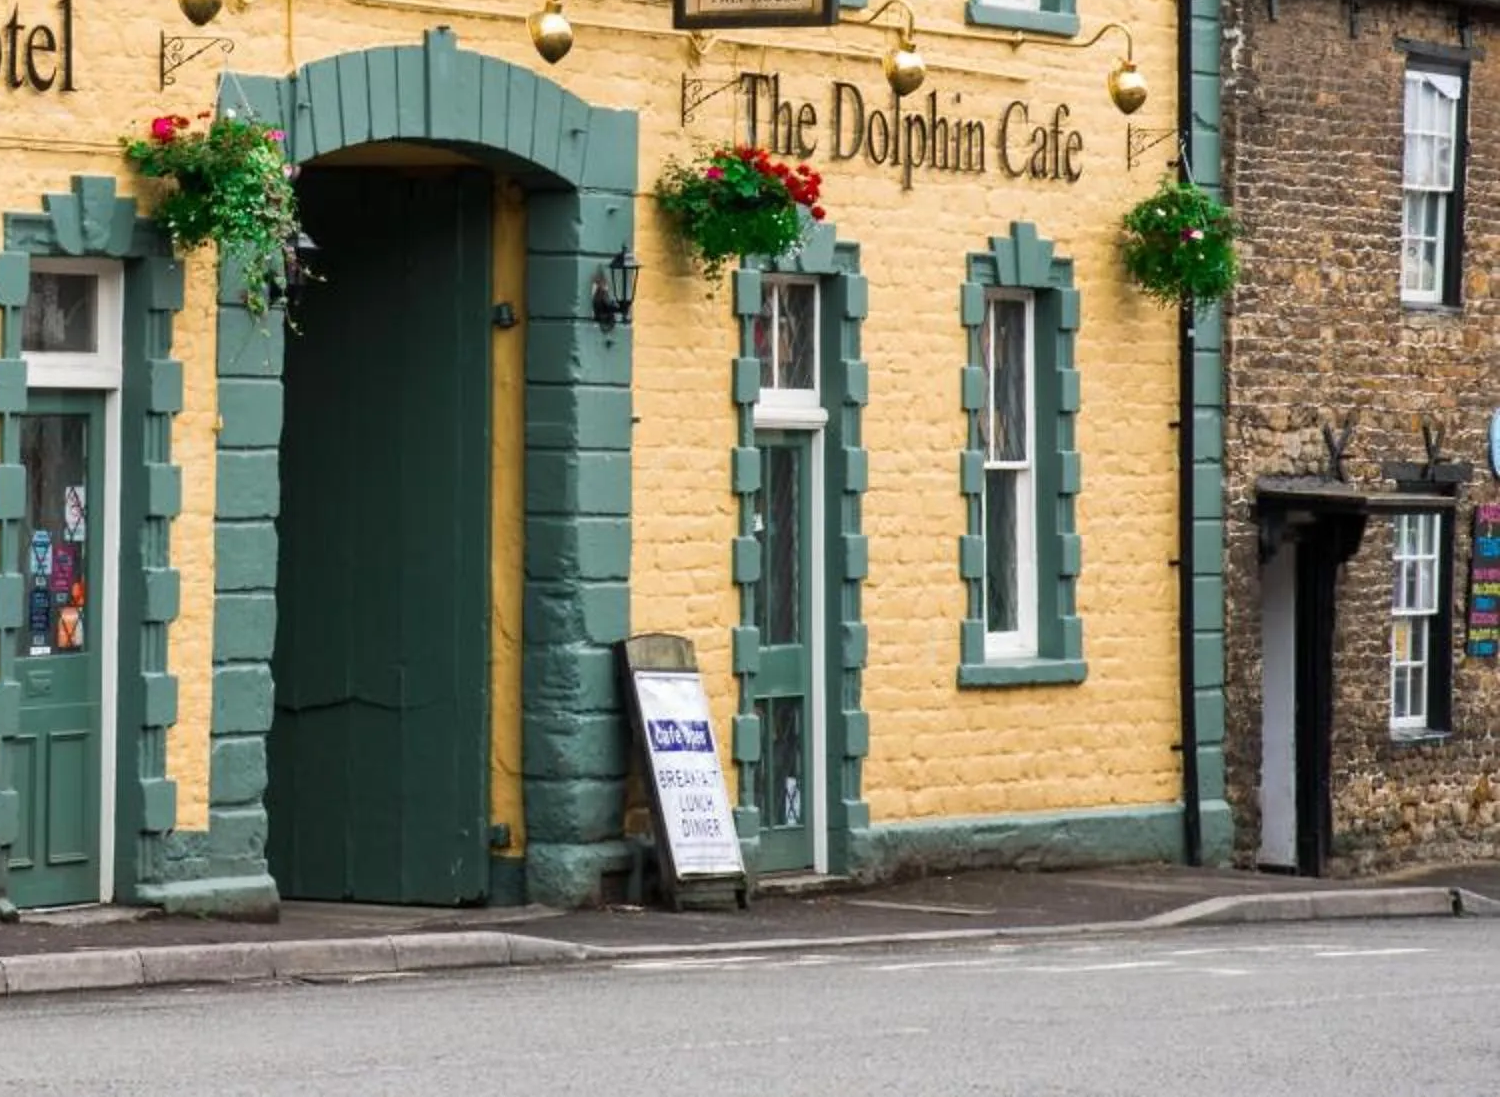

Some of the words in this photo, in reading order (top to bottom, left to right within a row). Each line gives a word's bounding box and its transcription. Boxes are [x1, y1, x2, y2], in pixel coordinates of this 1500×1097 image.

[739, 72, 818, 159] The
[831, 81, 986, 191] Dolphin
[999, 100, 1084, 183] Cafe
